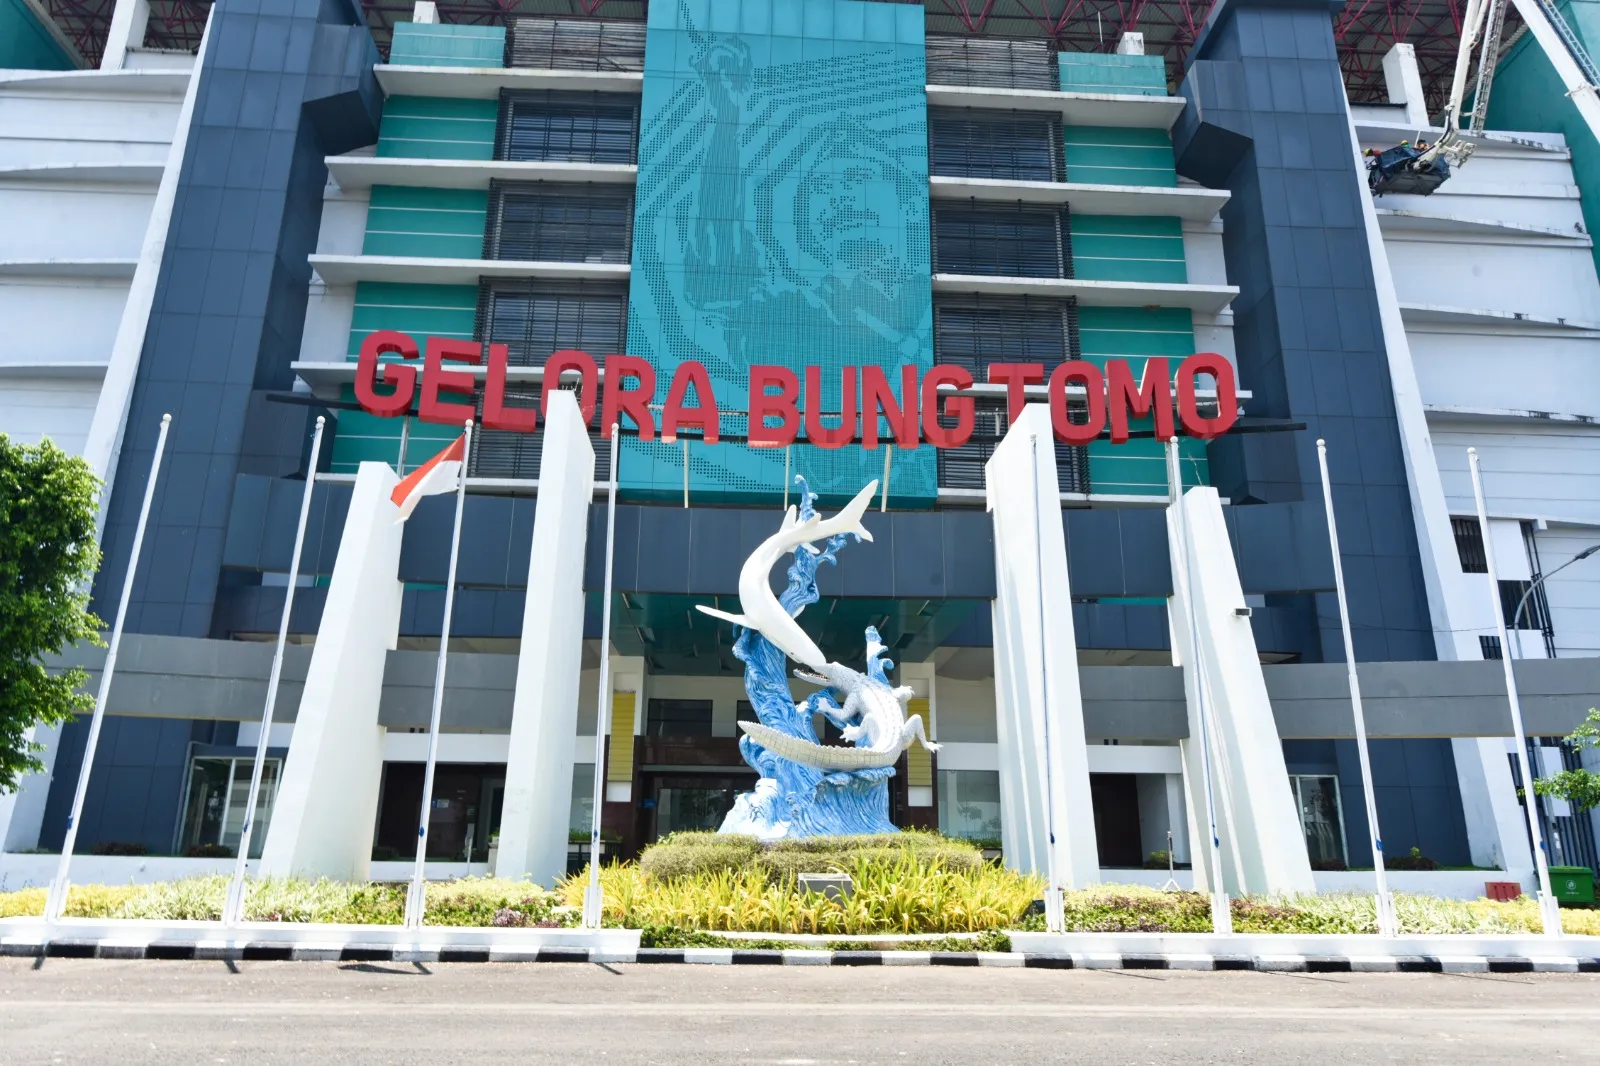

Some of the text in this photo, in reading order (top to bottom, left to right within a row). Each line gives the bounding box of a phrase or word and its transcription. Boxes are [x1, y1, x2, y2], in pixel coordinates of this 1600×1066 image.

[354, 330, 1237, 450] GELORA BUNG TOMO
